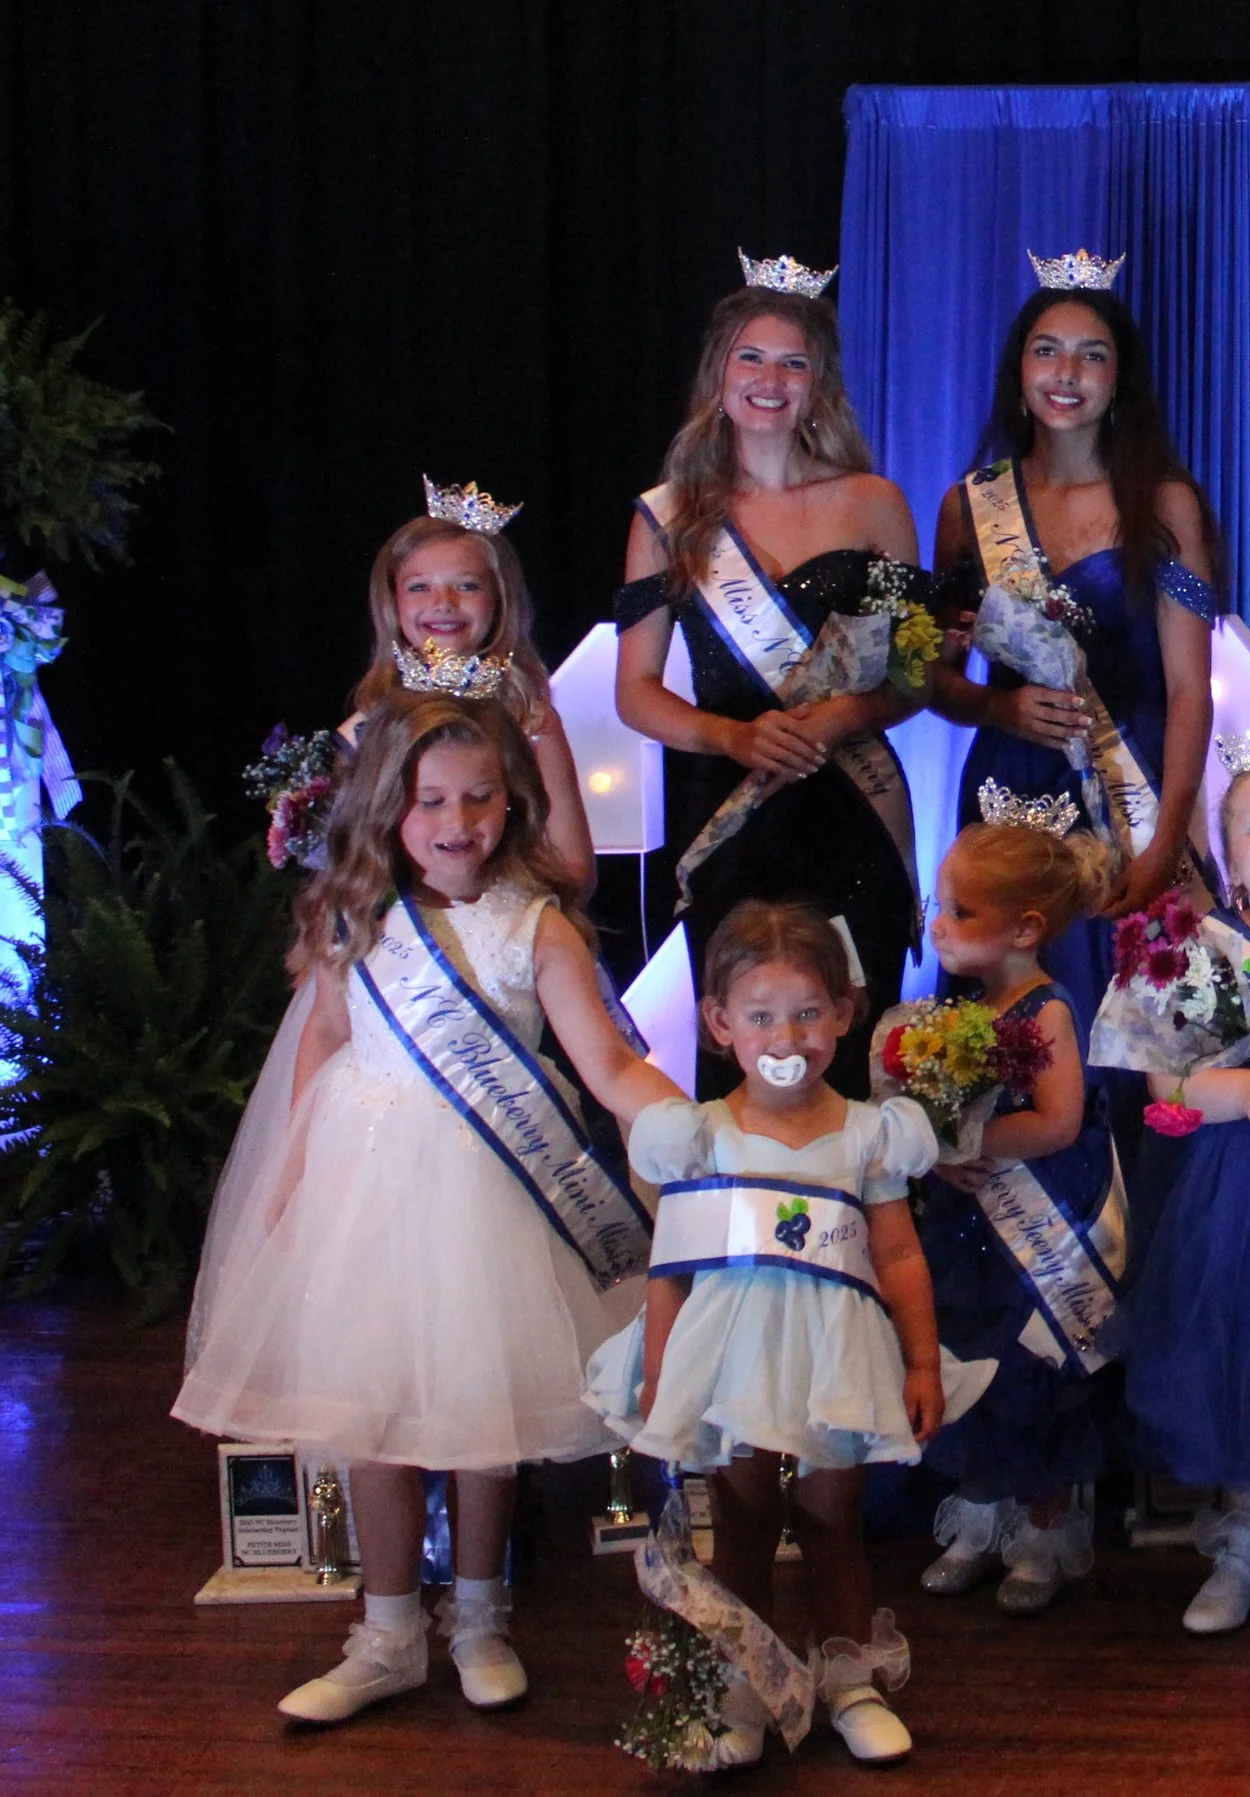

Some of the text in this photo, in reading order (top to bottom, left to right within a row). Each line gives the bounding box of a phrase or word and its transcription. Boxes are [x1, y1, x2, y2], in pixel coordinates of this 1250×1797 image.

[981, 488, 1009, 511] 2025
[711, 569, 758, 626] Miss
[400, 976, 467, 1028] NC
[448, 1031, 551, 1157] Blueberry
[542, 1151, 605, 1215] Mini
[819, 1220, 858, 1248] 2025
